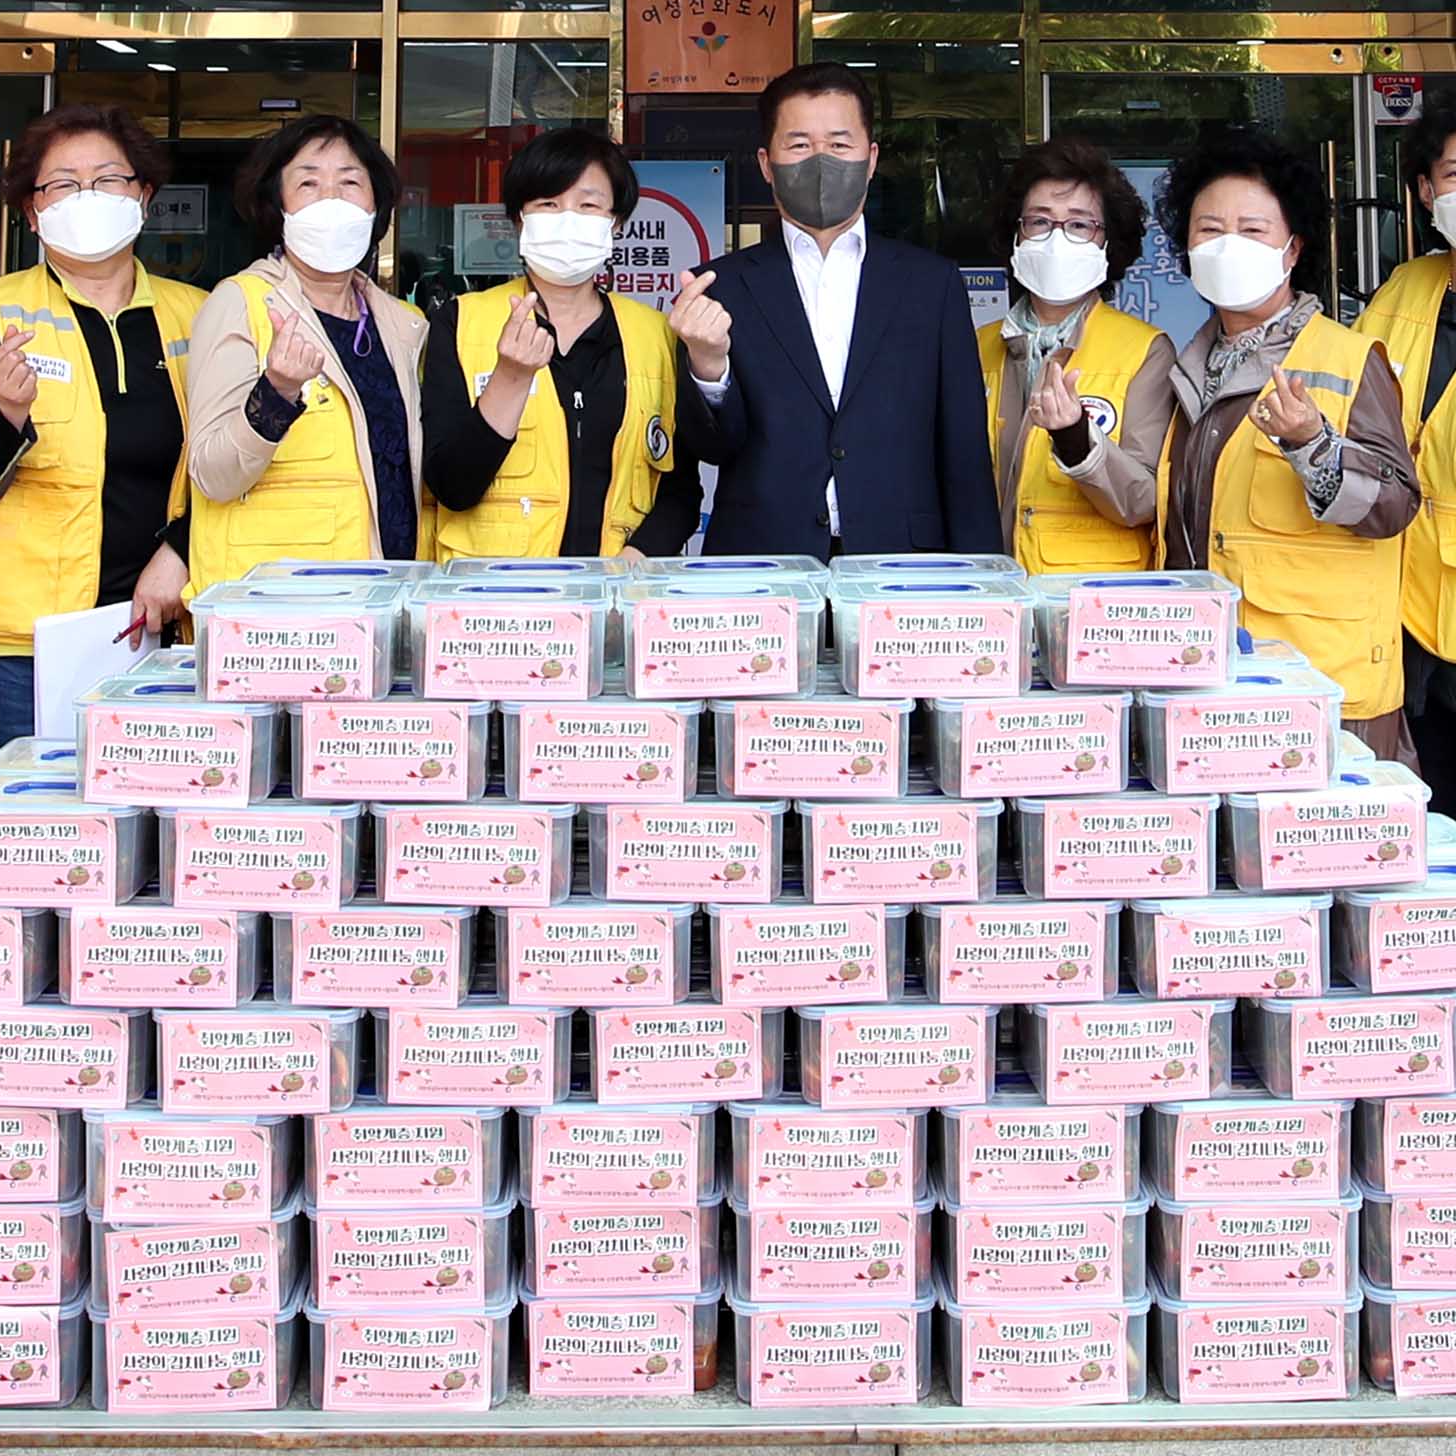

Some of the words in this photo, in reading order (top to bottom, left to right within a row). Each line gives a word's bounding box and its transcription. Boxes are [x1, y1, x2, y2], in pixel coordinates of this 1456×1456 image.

[610, 246, 670, 267] 회용품
[965, 275, 994, 286] TION
[26, 356, 66, 370] 적십자사
[1164, 605, 1193, 620] 지원
[523, 618, 552, 633] 지원
[1083, 624, 1125, 642] 사랑의
[1127, 625, 1183, 644] 김치나눔
[1184, 627, 1216, 643] 행사
[441, 637, 483, 656] 사랑의
[486, 639, 543, 657] 김치나눔
[545, 640, 576, 657] 행사
[1056, 712, 1085, 727] 지원
[185, 724, 214, 740] 지원
[976, 736, 1017, 754] 사랑의
[1020, 734, 1075, 753] 김치나눔
[1077, 733, 1108, 749] 행사
[101, 741, 144, 761] 사랑의
[146, 744, 204, 765] 김치나눔
[206, 748, 238, 765] 행사
[705, 820, 734, 835] 지원
[1142, 815, 1171, 829] 지원
[274, 828, 304, 844] 지원
[623, 839, 665, 858] 사랑의
[668, 841, 725, 860] 김치나눔
[727, 843, 759, 859] 행사
[1060, 837, 1102, 855] 사랑의
[1105, 837, 1162, 854] 김치나눔
[1164, 837, 1195, 852] 행사
[190, 847, 233, 866] 사랑의
[236, 849, 294, 869] 김치나눔
[296, 851, 328, 869] 행사
[171, 924, 200, 939] 지원
[607, 924, 636, 938] 지원
[1385, 928, 1425, 948] 사랑의
[87, 944, 130, 962] 사랑의
[133, 945, 191, 964] 김치나눔
[193, 946, 225, 963] 행사
[524, 945, 566, 963] 사랑의
[569, 946, 627, 963] 김치나눔
[629, 946, 660, 962] 행사
[61, 1023, 90, 1039] 지원
[262, 1030, 291, 1045] 지원
[919, 1025, 948, 1039] 지원
[22, 1044, 81, 1064] 김치나눔
[82, 1047, 115, 1064] 행사
[178, 1052, 221, 1070] 사랑의
[224, 1053, 282, 1070] 김치나눔
[285, 1053, 316, 1069] 행사
[836, 1048, 879, 1066] 사랑의
[882, 1047, 939, 1065] 김치나눔
[942, 1046, 973, 1062] 행사
[414, 1126, 444, 1140] 지원
[1058, 1122, 1088, 1136] 지원
[331, 1147, 374, 1164] 사랑의
[377, 1147, 435, 1164] 김치나눔
[437, 1148, 469, 1163] 행사
[975, 1144, 1018, 1162] 사랑의
[1021, 1144, 1078, 1161] 김치나눔
[1081, 1143, 1112, 1159] 행사
[1407, 1228, 1449, 1246] 사랑의
[16, 1243, 48, 1259] 행사
[1276, 1317, 1306, 1332] 지원
[1194, 1341, 1236, 1359] 사랑의
[1239, 1339, 1297, 1358] 김치나눔
[1299, 1338, 1331, 1354] 행사
